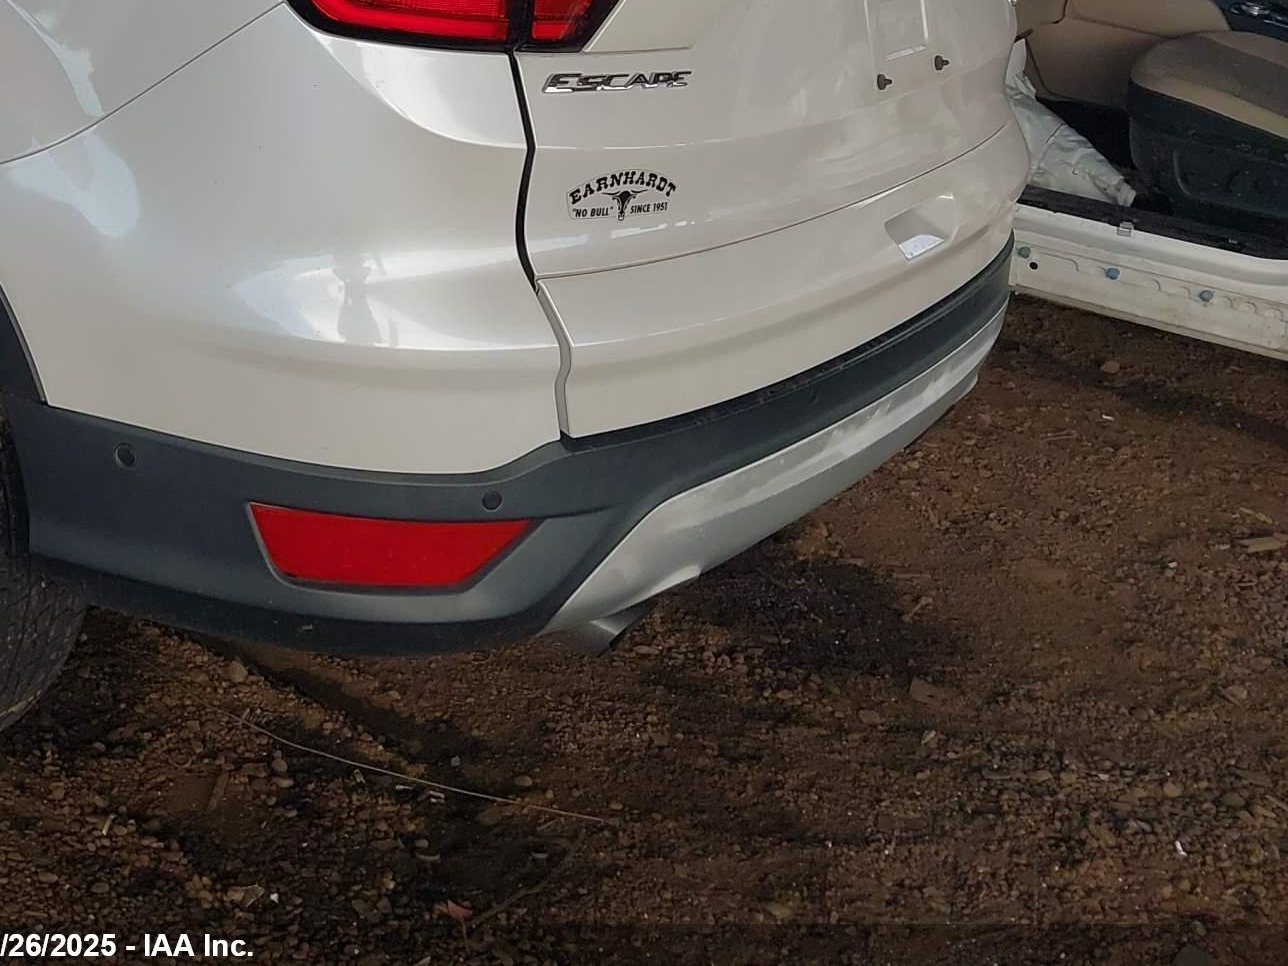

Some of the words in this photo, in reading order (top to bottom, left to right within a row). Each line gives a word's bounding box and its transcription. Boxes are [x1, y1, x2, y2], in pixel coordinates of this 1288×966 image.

[542, 71, 693, 94] ESCAPE
[568, 170, 678, 205] EARNHARDT
[572, 207, 588, 218] "NO
[590, 205, 614, 217] BULL"
[629, 203, 651, 215] SINCE
[652, 201, 669, 213] 1951
